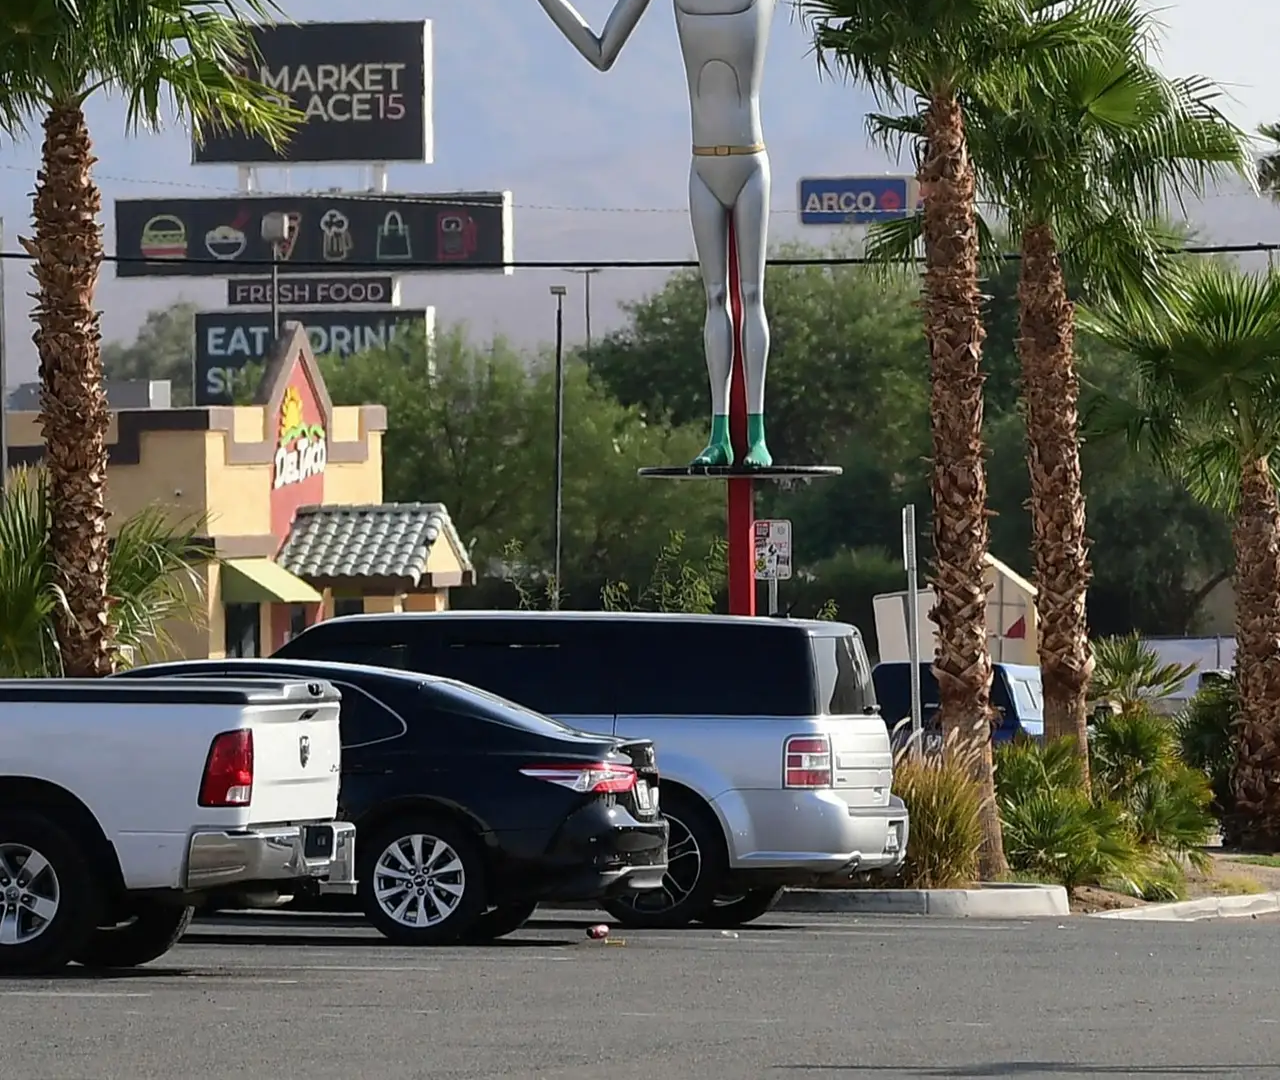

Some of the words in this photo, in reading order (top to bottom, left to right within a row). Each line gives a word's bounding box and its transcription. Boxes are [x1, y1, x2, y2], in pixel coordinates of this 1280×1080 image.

[261, 63, 405, 92] MARKET
[805, 191, 876, 213] ARCO
[236, 284, 308, 302] FRESH
[317, 283, 384, 301] FOOD
[207, 326, 269, 355] EAT
